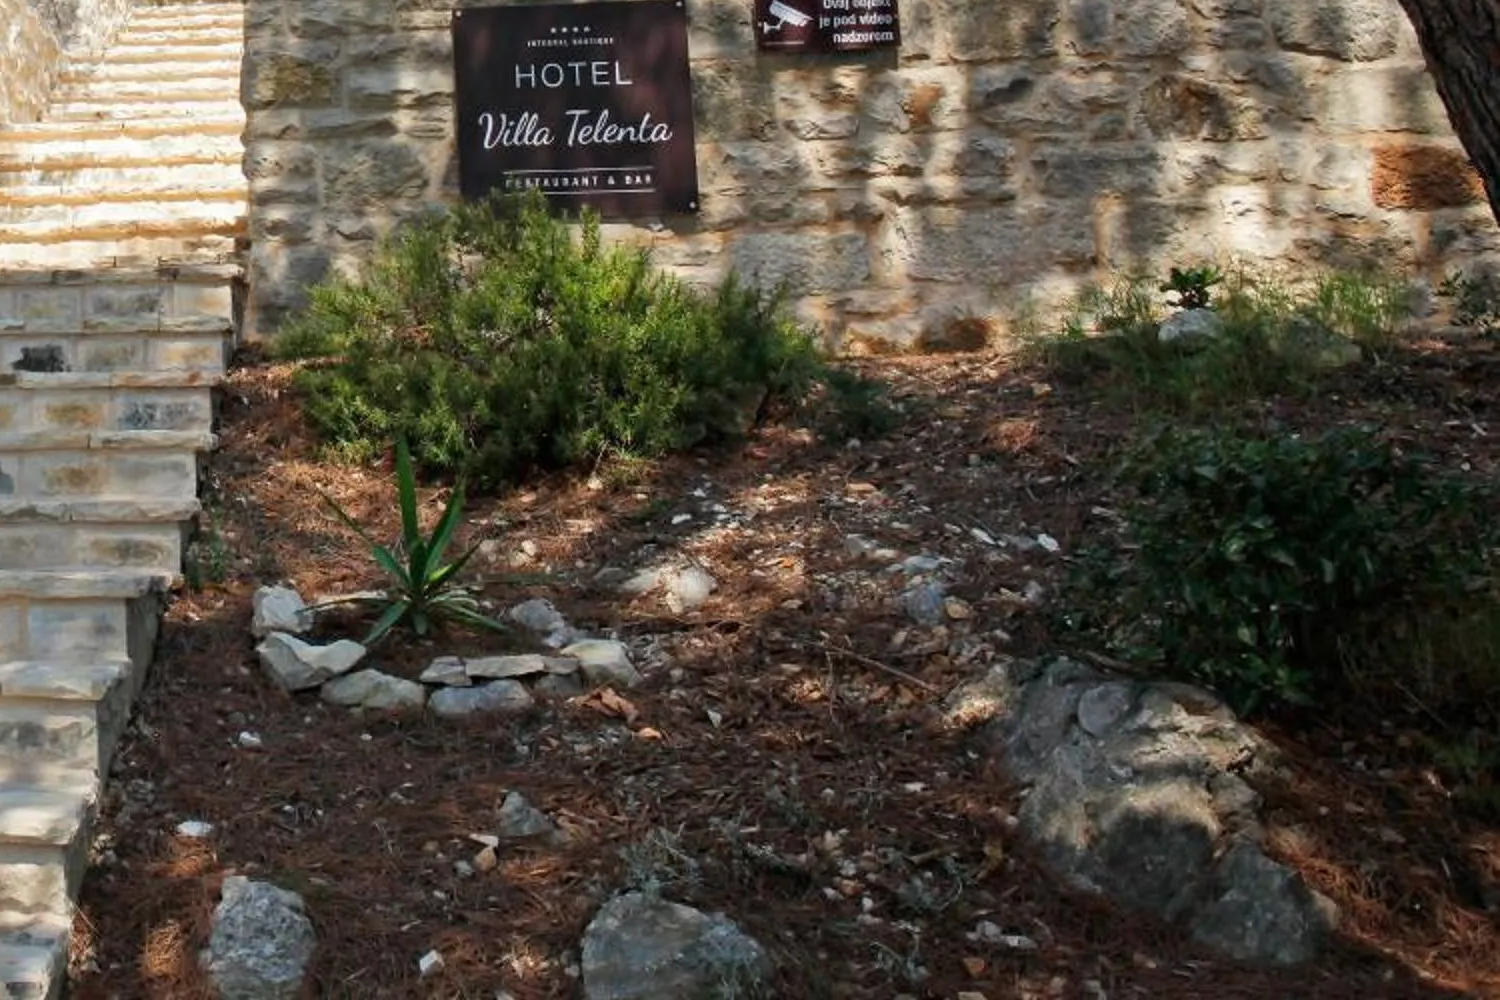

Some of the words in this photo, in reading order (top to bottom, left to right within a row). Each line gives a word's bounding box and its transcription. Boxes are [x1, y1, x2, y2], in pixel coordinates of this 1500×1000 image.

[819, 15, 831, 29] je
[833, 13, 856, 28] pod
[514, 60, 633, 89] HOTEL
[478, 110, 555, 150] Villa
[564, 108, 673, 148] Telenta
[625, 173, 652, 186] BAR
